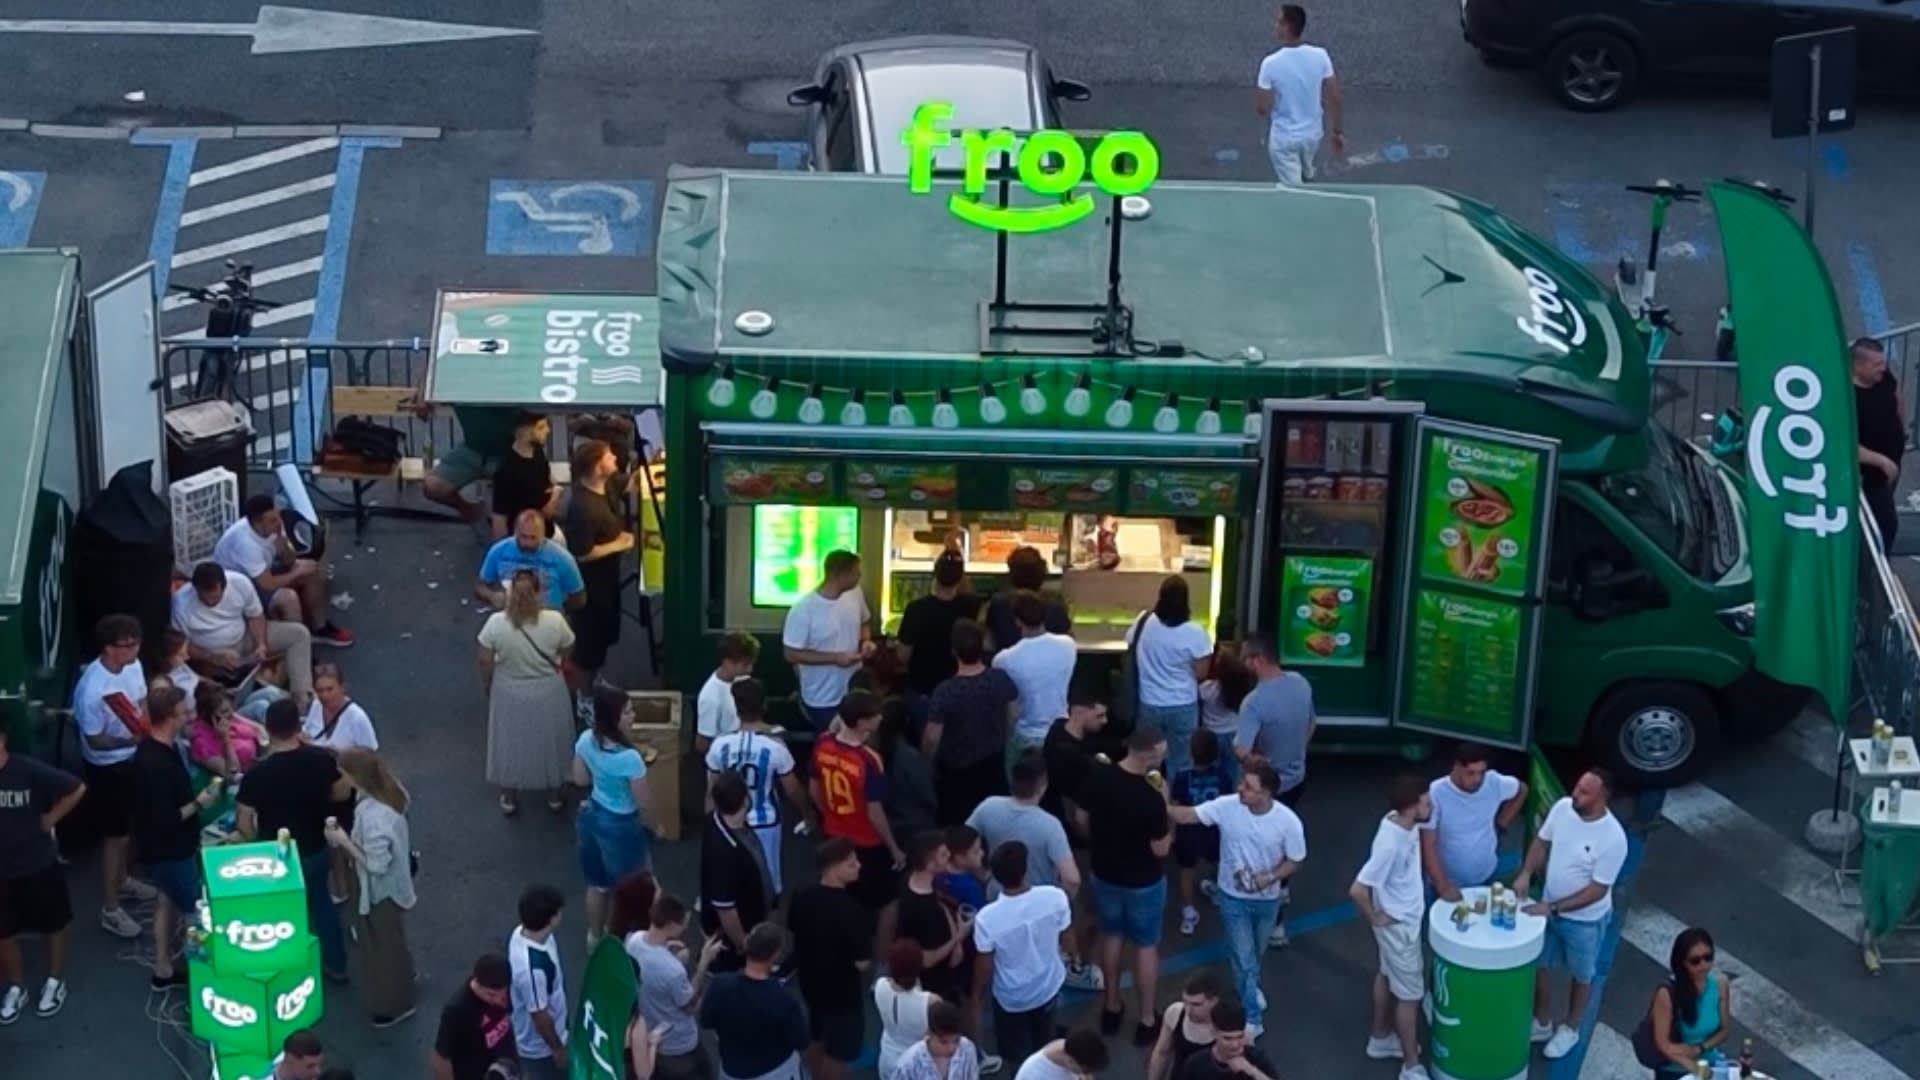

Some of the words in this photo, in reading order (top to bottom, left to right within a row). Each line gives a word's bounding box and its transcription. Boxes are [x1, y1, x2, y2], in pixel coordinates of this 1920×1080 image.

[902, 100, 1162, 197] froo
[1517, 266, 1570, 353] froo
[540, 310, 599, 404] bistro
[606, 311, 643, 357] froo
[822, 766, 856, 816] 19
[226, 920, 294, 945] froo
[201, 986, 257, 1024] froo
[275, 977, 315, 1020] froo
